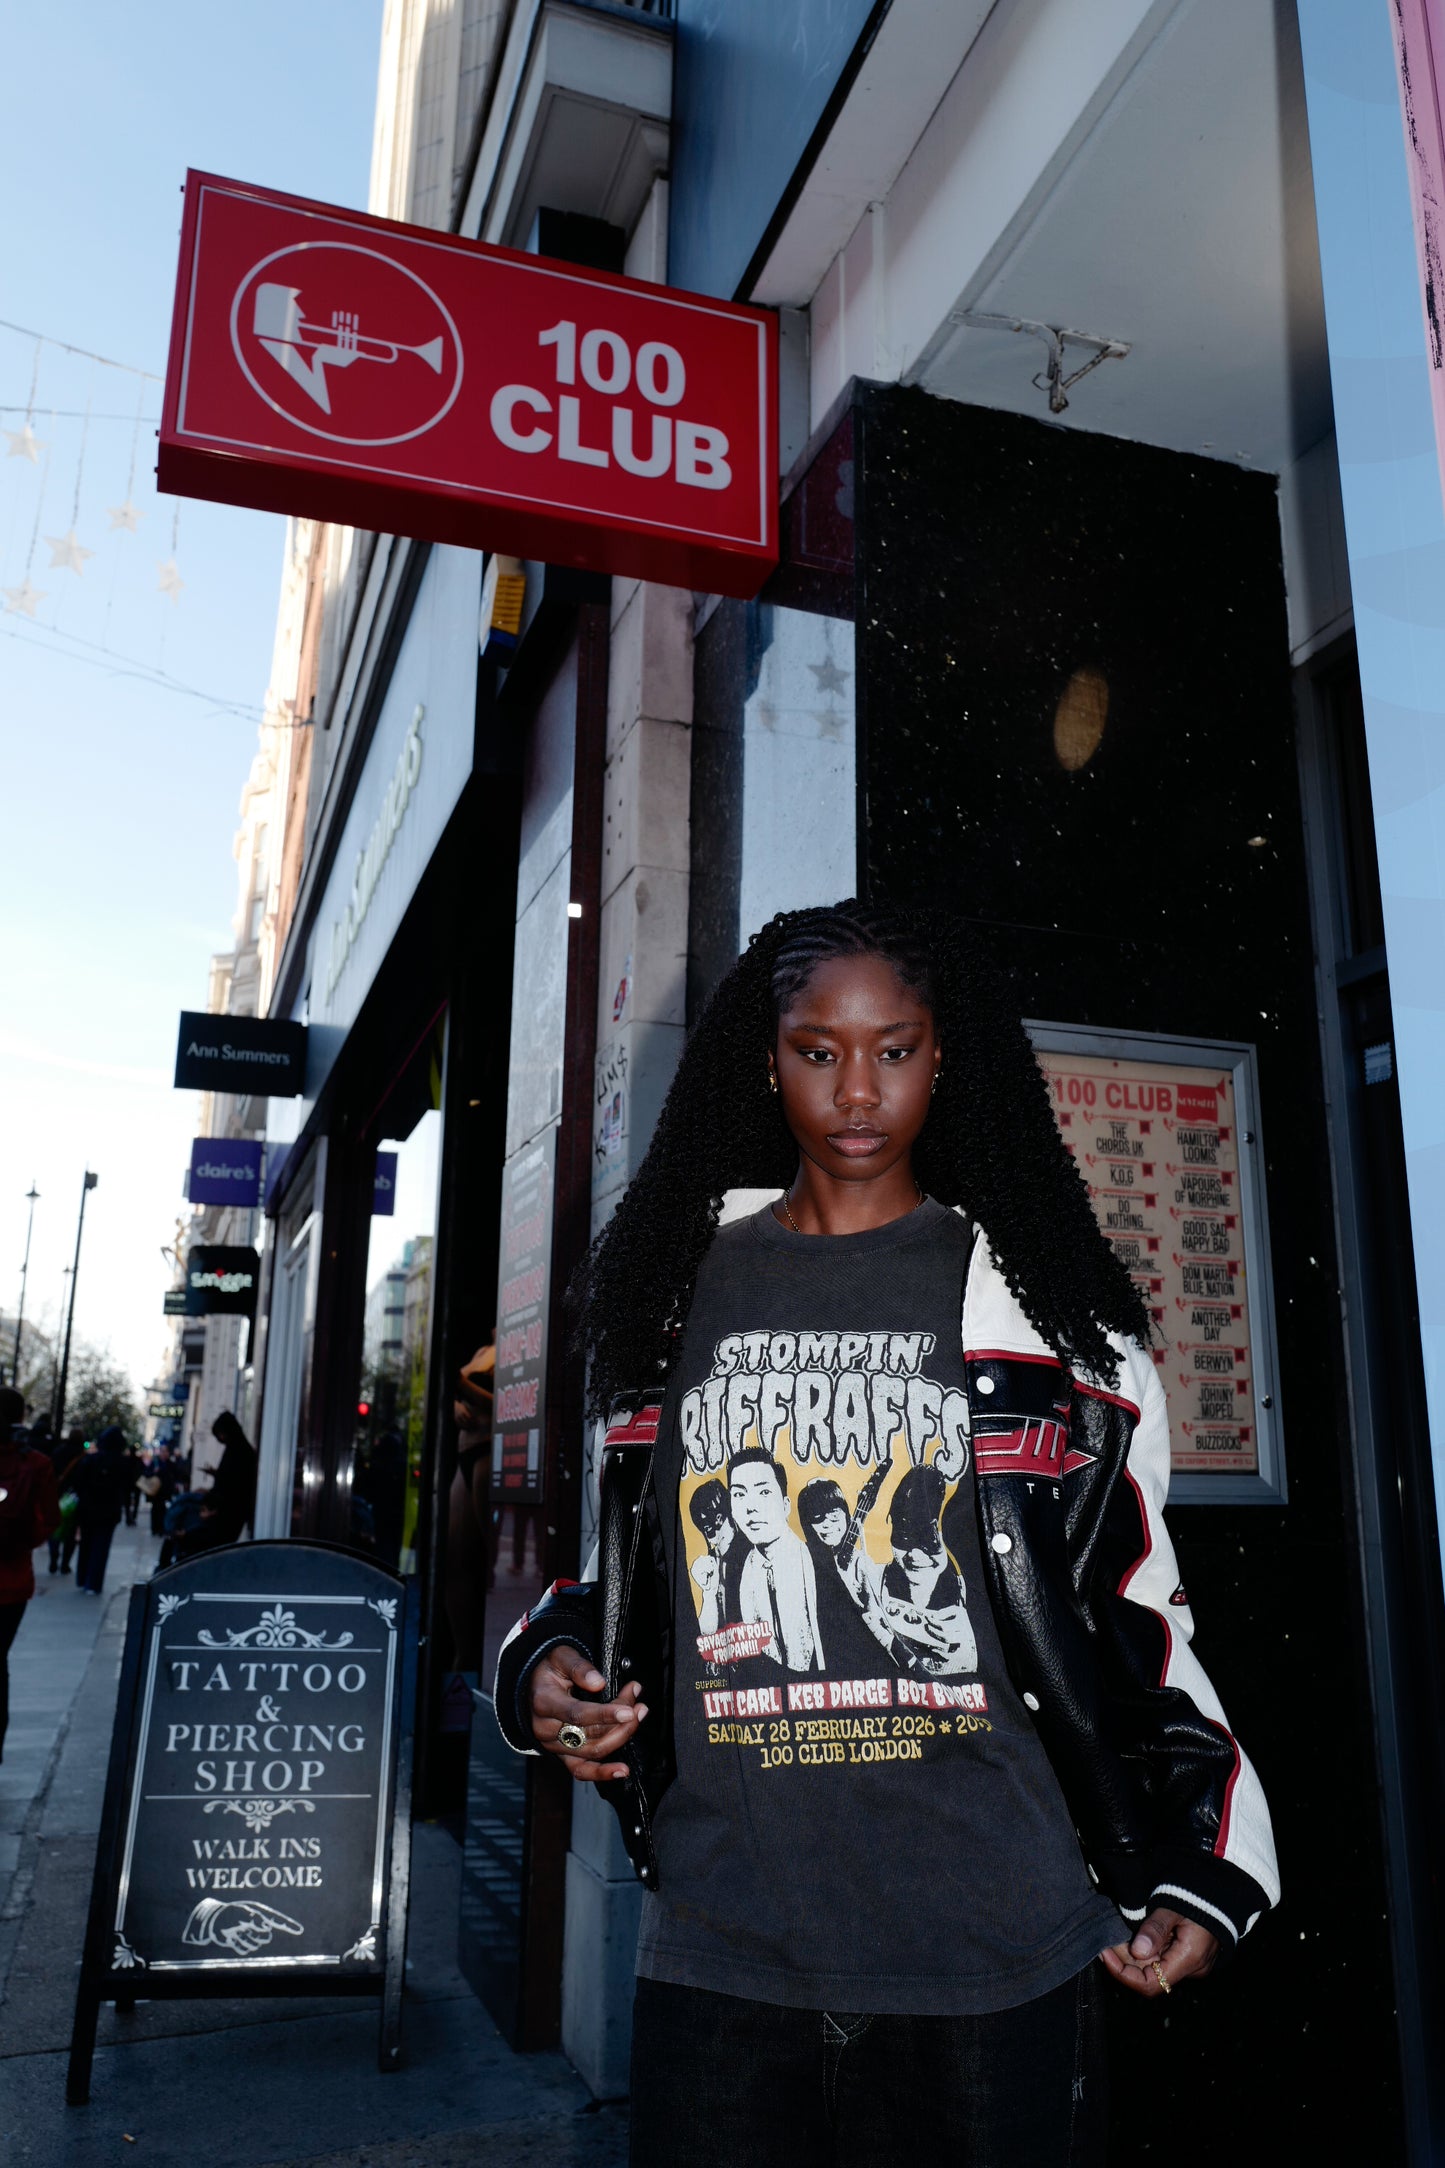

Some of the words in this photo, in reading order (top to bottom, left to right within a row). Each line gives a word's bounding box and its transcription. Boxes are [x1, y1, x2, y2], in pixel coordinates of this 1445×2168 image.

[538, 320, 686, 407] 100
[489, 383, 733, 491] CLUB
[185, 1041, 219, 1058] Ann
[221, 1044, 291, 1066] Summers
[1055, 1077, 1096, 1107] 100
[1105, 1082, 1173, 1113] CLUB
[1111, 1125, 1127, 1140] THE
[1176, 1131, 1221, 1149] HAMILTON
[1096, 1137, 1130, 1153] CHORDS
[1132, 1139, 1144, 1154] UK
[1182, 1146, 1217, 1162] LOOMIS
[195, 1162, 256, 1181] claire's
[1181, 1176, 1222, 1192] VAPOURS
[1118, 1199, 1130, 1213] DO
[1175, 1190, 1186, 1203] OF
[1188, 1191, 1230, 1207] MORPHINE
[1106, 1213, 1143, 1228] NOTHING
[1183, 1220, 1208, 1236] GOOD
[1210, 1221, 1227, 1237] SAD
[1181, 1235, 1210, 1251] HAPPY
[1212, 1237, 1230, 1253] BAD
[190, 1267, 253, 1293] smiggle
[1182, 1266, 1201, 1280] DOM
[1183, 1280, 1204, 1295] BLUE
[1206, 1281, 1235, 1296] NATION
[1191, 1311, 1232, 1327] ANOTHER
[1204, 1327, 1221, 1342] DAY
[714, 1331, 936, 1374] STOMPIN'
[1194, 1355, 1234, 1370] BERWYN
[1198, 1387, 1235, 1402] JOHNNY
[150, 1405, 184, 1417] NEXT
[1201, 1403, 1233, 1418] MOPED
[680, 1371, 972, 1483] RIFFRAFFS
[1196, 1435, 1243, 1450] BUZZCOCKS
[172, 1661, 367, 1693] TATTOO
[694, 1679, 729, 1690] SUPPORT:
[736, 1686, 780, 1716] CARL
[788, 1683, 825, 1711] KEB
[829, 1680, 890, 1709] DARGE
[897, 1678, 929, 1706] BOZ
[255, 1694, 281, 1723] &
[769, 1718, 791, 1743] 28
[794, 1716, 888, 1742] FEBRUARY
[892, 1714, 936, 1736] 2026
[165, 1724, 366, 1754] PIERCING
[760, 1745, 794, 1768] 100
[798, 1742, 846, 1765] CLUB
[850, 1739, 923, 1763] LONDON
[194, 1759, 325, 1793] SHOP
[191, 1838, 271, 1861] WALK
[280, 1837, 322, 1859] INS
[185, 1865, 323, 1890] WELCOME
